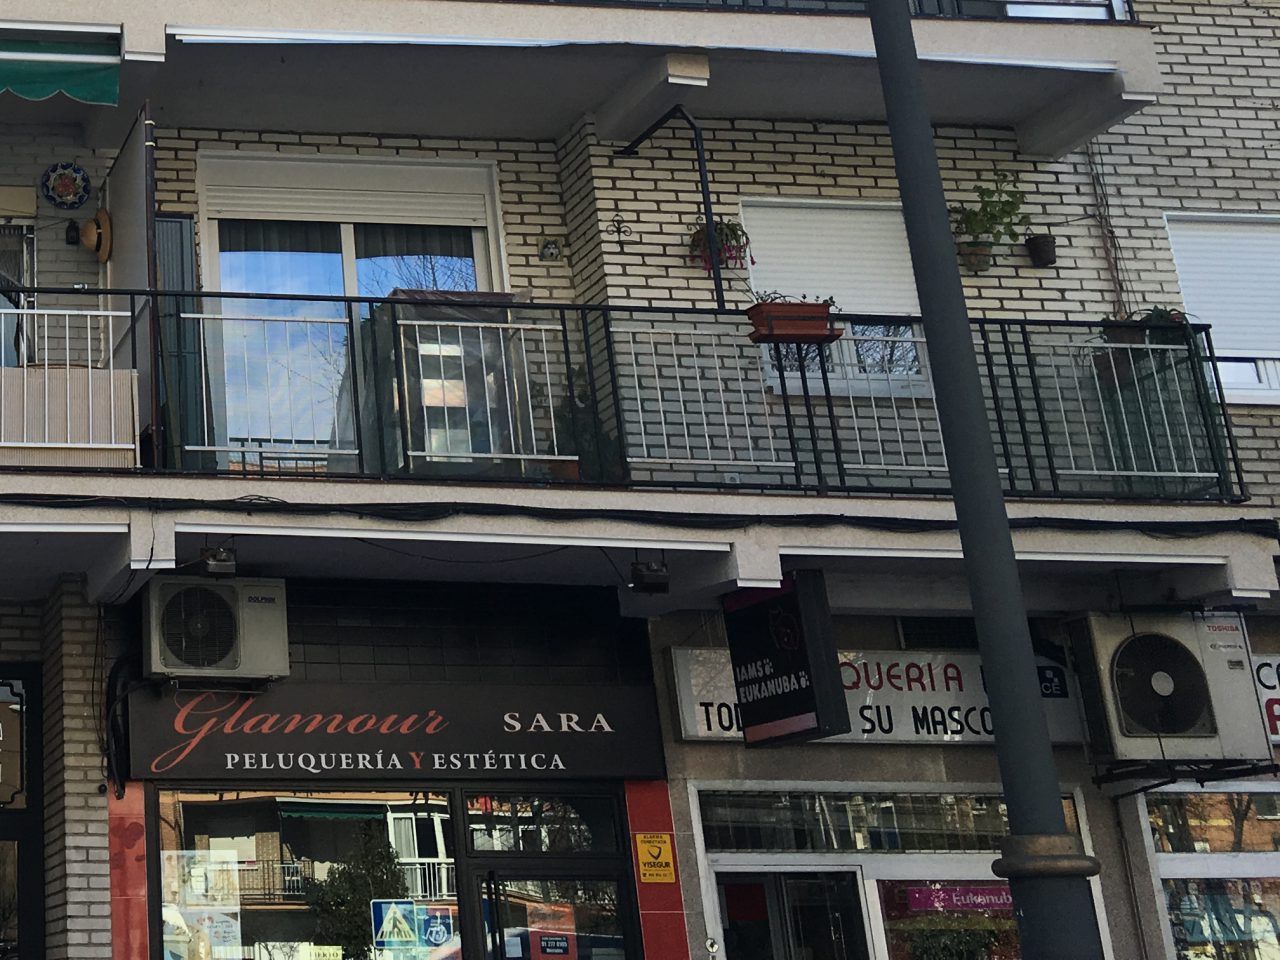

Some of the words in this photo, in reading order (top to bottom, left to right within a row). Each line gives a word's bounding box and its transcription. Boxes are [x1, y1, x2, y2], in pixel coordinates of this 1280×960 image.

[736, 660, 764, 682] IAMS
[739, 674, 799, 704] EUKANUBA
[151, 691, 450, 773] Glamour
[503, 712, 615, 732] SARA
[859, 705, 894, 734] SU
[225, 749, 404, 773] PELUQUERÍA
[409, 751, 425, 769] Y
[432, 749, 567, 769] ESTÉTICA
